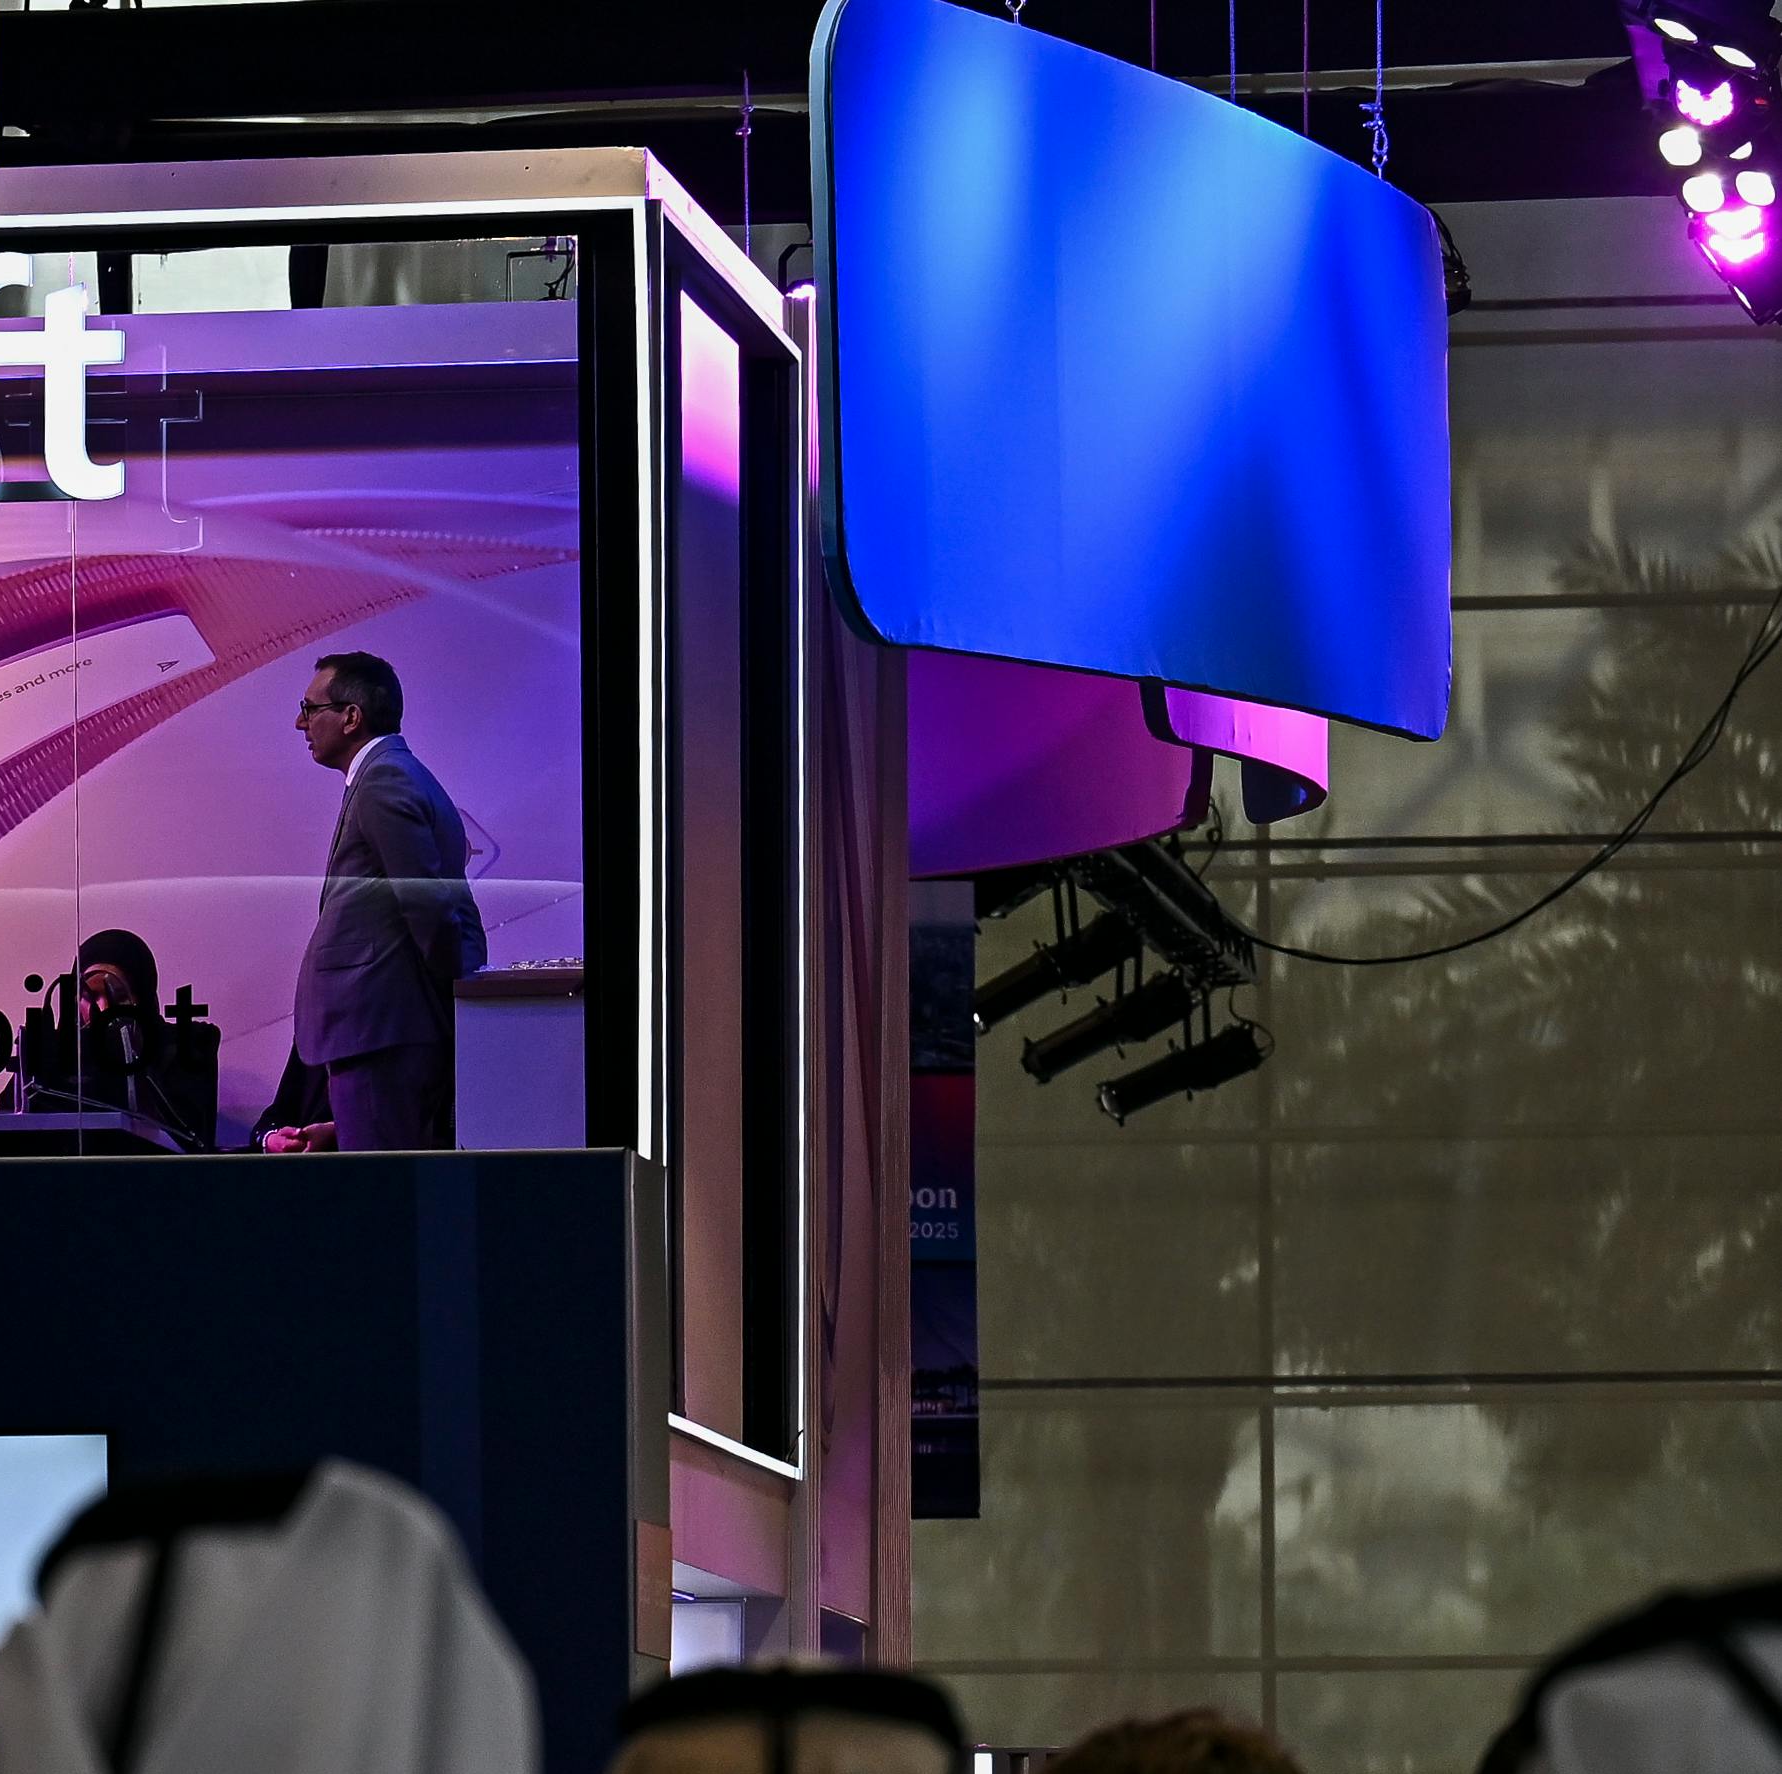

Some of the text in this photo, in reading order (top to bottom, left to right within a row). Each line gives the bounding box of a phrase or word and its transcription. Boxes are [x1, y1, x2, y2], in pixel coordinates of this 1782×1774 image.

[14, 673, 46, 695] and
[48, 656, 94, 681] more
[910, 1187, 957, 1209] on
[911, 1221, 960, 1240] 2025
